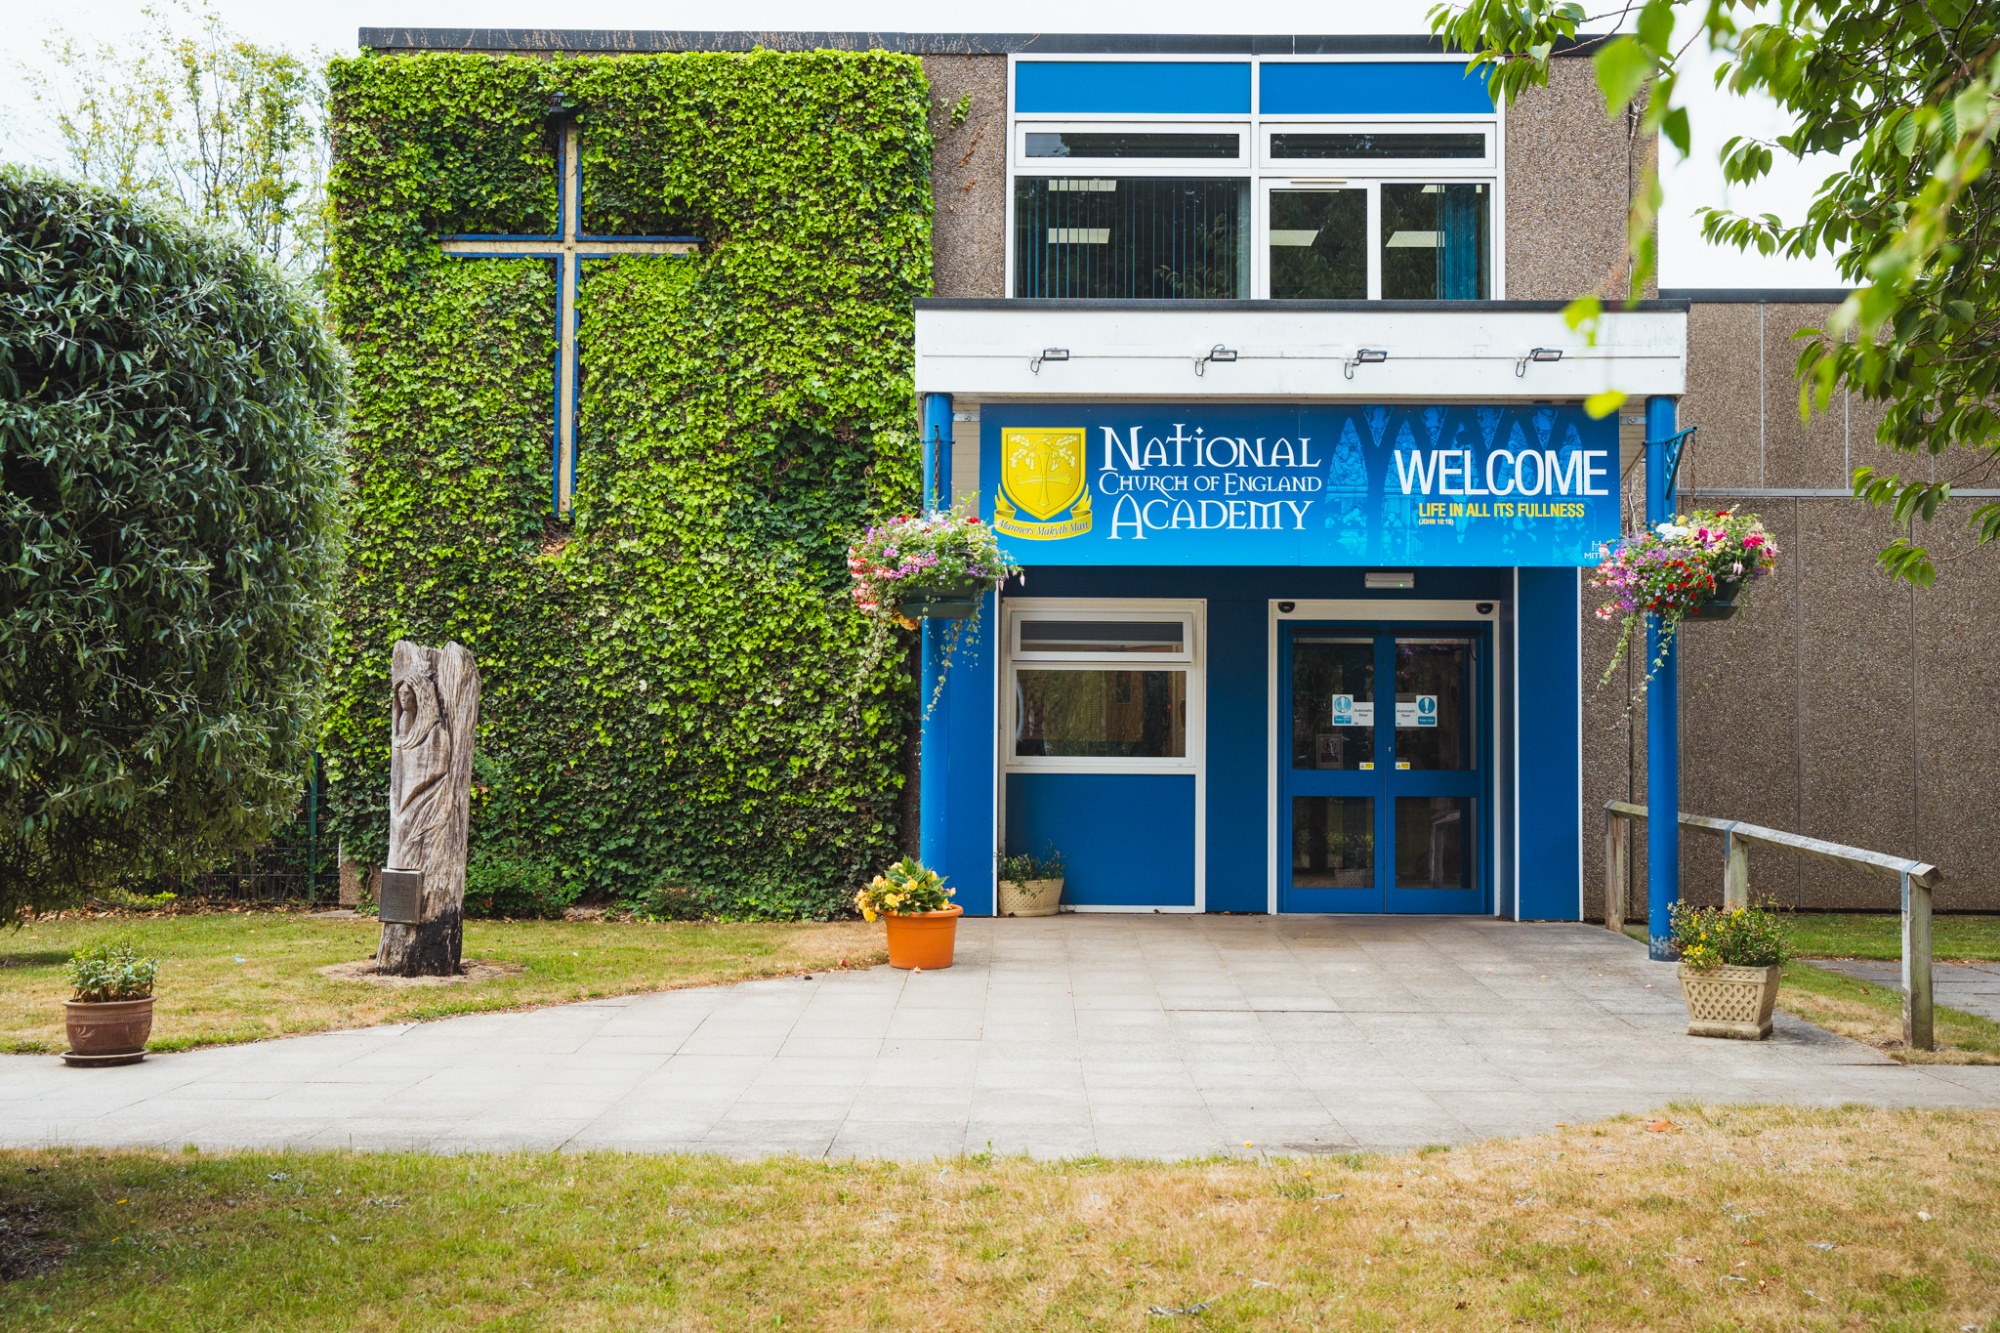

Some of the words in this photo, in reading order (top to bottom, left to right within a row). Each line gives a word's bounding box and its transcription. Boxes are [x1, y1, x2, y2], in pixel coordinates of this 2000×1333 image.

[1099, 472, 1188, 502] CHURCH
[1194, 475, 1220, 492] OF
[1223, 472, 1322, 496] ENGLAND
[1394, 449, 1609, 496] WELCOME
[1106, 493, 1315, 540] ACADEMY
[1418, 502, 1447, 517] LIFE
[1449, 502, 1463, 517] IN
[1466, 502, 1491, 517] ALL
[1494, 502, 1514, 517] ITS
[1517, 502, 1585, 518] FULLNESS
[999, 519, 1035, 535] Manners
[1069, 521, 1089, 533] Man
